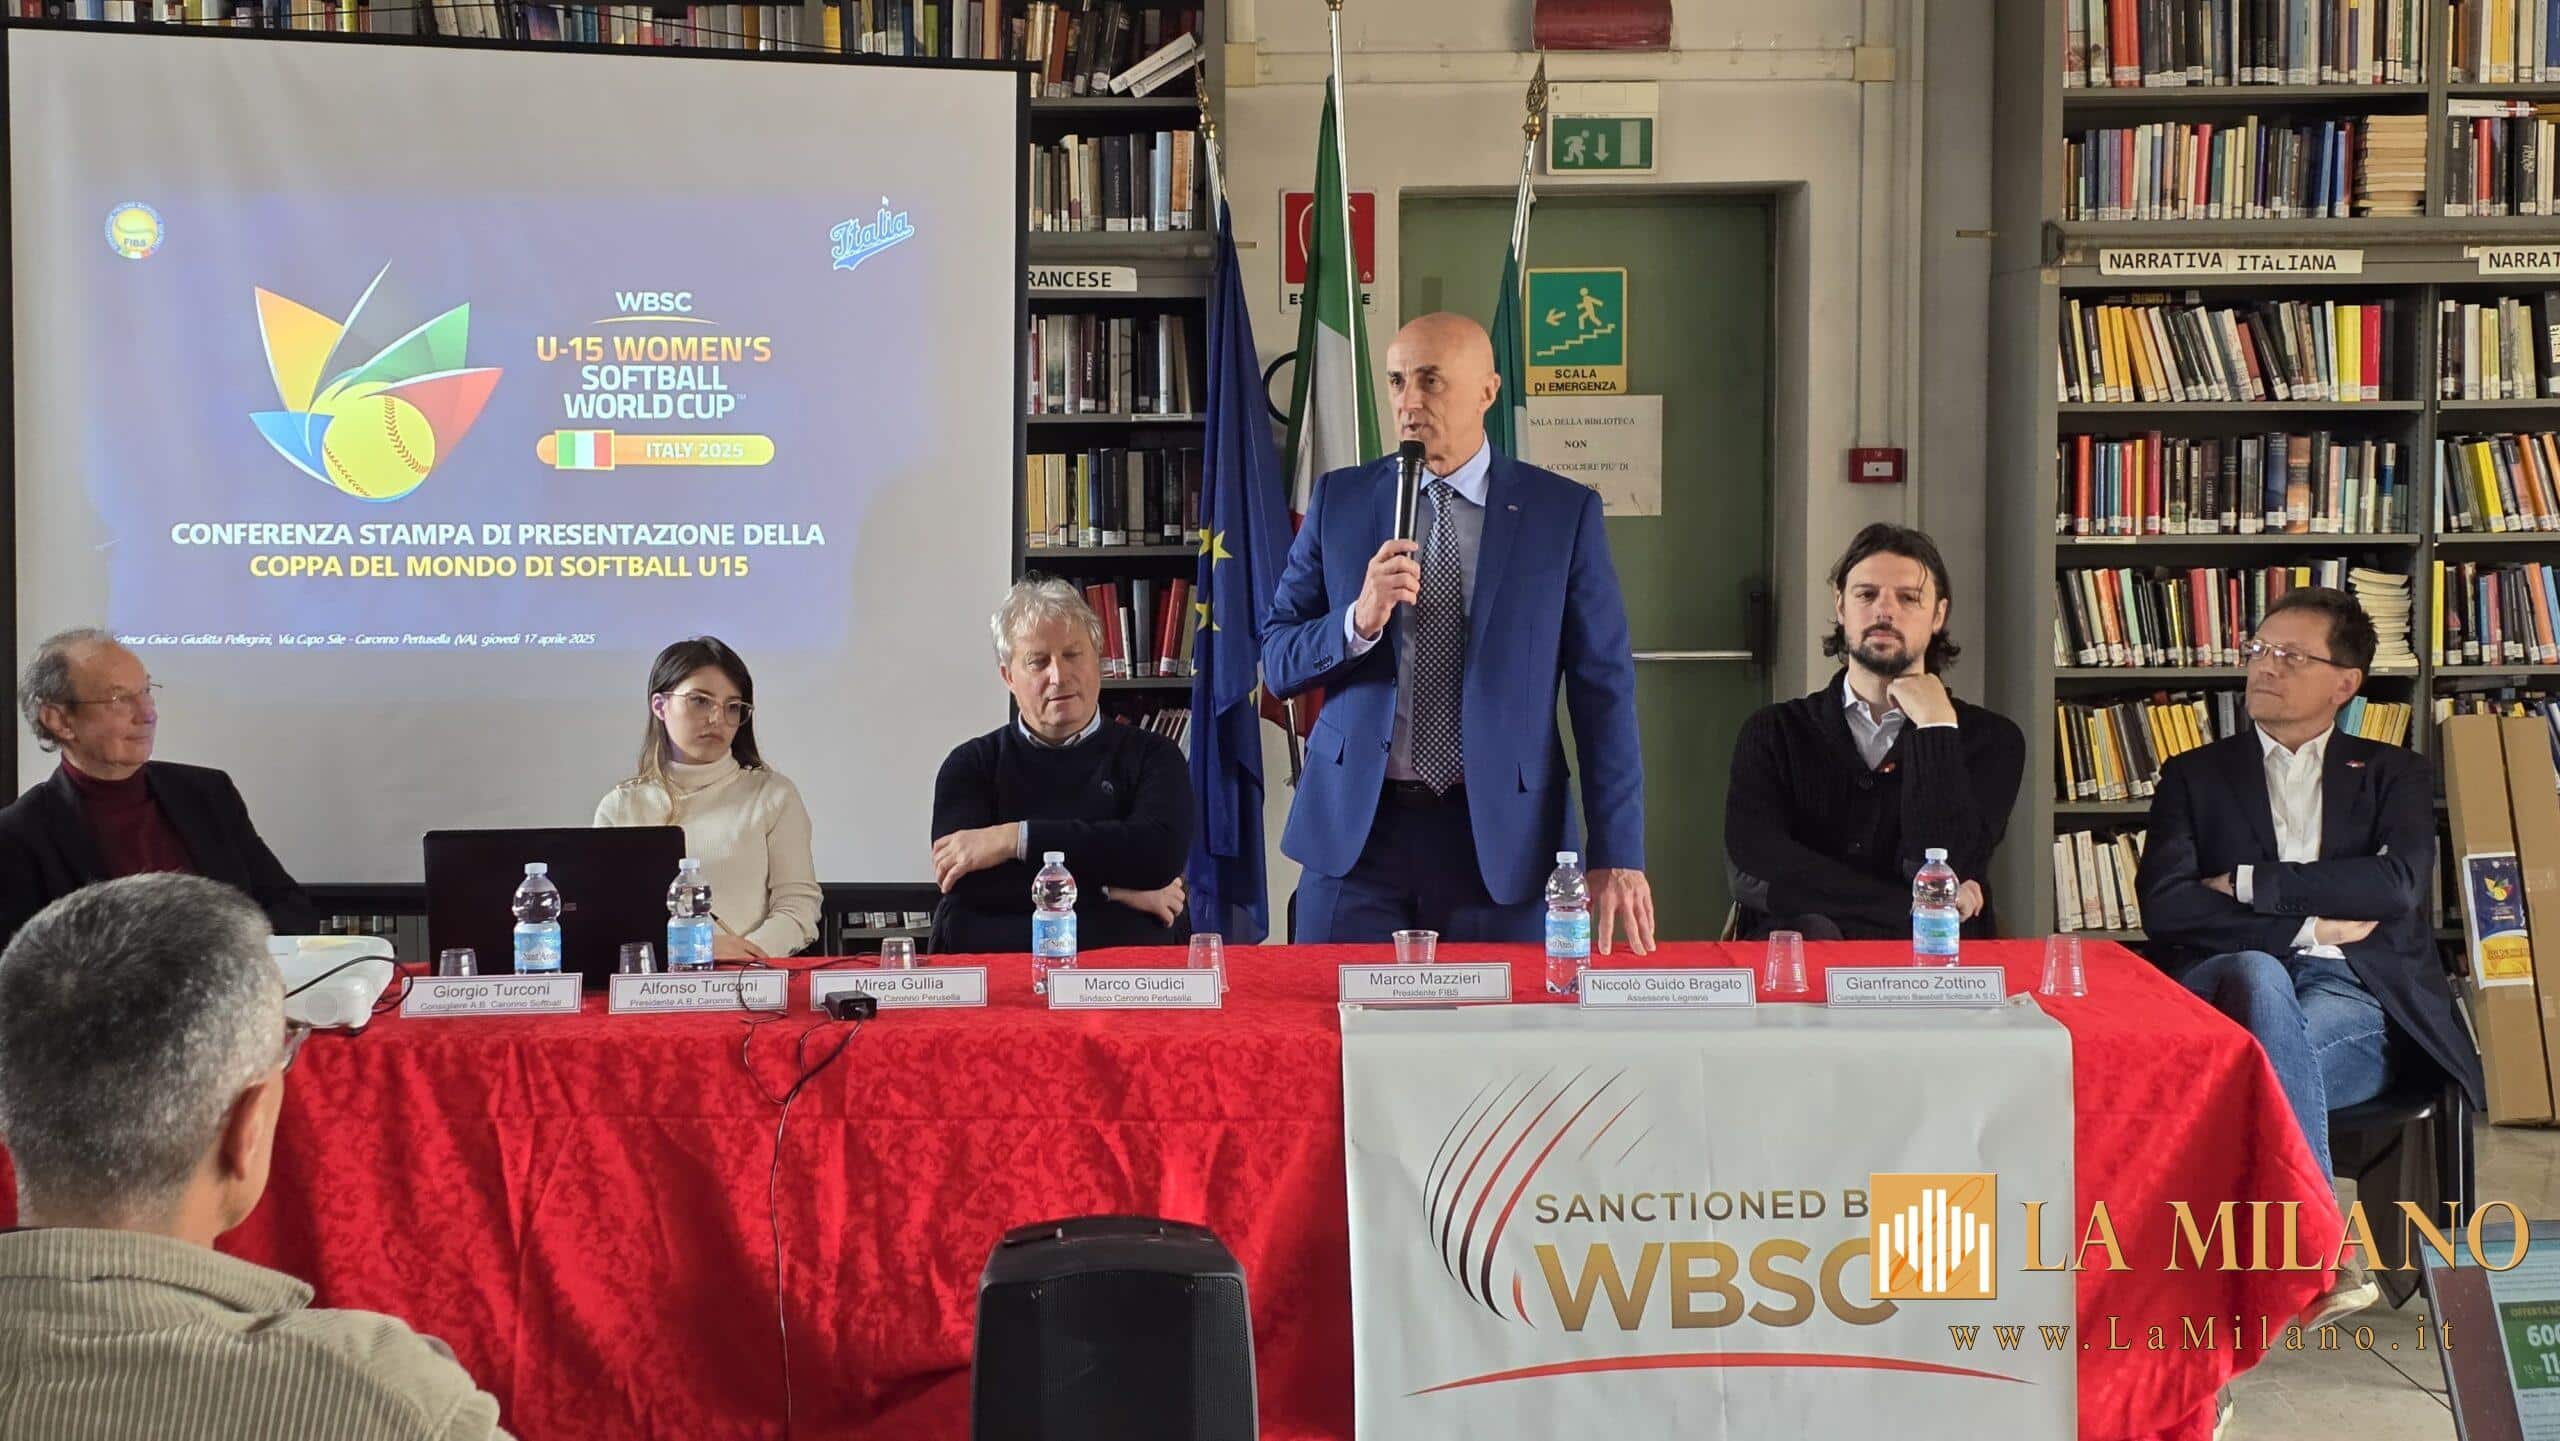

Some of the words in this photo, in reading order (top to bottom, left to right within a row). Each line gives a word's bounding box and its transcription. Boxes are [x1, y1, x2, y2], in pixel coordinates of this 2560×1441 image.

[2109, 252, 2223, 269] NARRATIVA
[2237, 254, 2337, 271] ITALIANA
[1028, 271, 1112, 288] RANCESE
[615, 291, 692, 312] WBSC
[536, 335, 604, 362] U-15
[613, 335, 772, 362] WOMEN'S
[581, 364, 728, 390] SOFTBALL
[1555, 369, 1597, 379] SCALA
[1534, 382, 1546, 392] DI
[1548, 381, 1617, 392] EMERGENZA
[563, 393, 674, 419] WORLD
[676, 393, 736, 419] CUP
[1530, 418, 1552, 426] SALA
[1554, 418, 1582, 426] DELLA
[1584, 417, 1636, 426] BIBLIOTECA
[646, 442, 694, 458] ITALY
[699, 442, 744, 458] 2025
[1564, 439, 1588, 448] NON
[170, 523, 354, 546] CONFERENZA
[358, 523, 475, 546] STAMPA
[481, 523, 512, 546] DI
[517, 523, 736, 546] PRESENTAZIONE
[743, 523, 826, 546] DELLA
[250, 555, 344, 578] COPPA
[349, 555, 399, 578] DEL
[406, 555, 518, 578] MONDO
[524, 555, 554, 578] DI
[560, 555, 693, 578] SOFTBALL
[698, 555, 750, 578] U15
[114, 634, 146, 645] oteca
[296, 634, 325, 648] Capo
[524, 633, 536, 644] 17
[569, 633, 597, 644] 2025
[855, 978, 896, 992] Mirea
[901, 977, 944, 990] Gullia
[1084, 977, 1130, 991] Marco
[1134, 977, 1185, 990] Giudici
[1370, 973, 1416, 985] Marco
[1420, 972, 1481, 985] Mazzieri
[1591, 979, 1641, 990] Niccolò
[1645, 979, 1685, 990] Guido
[1689, 979, 1742, 992] Bragato
[1846, 976, 1929, 990] Gianfranco
[1934, 977, 1986, 990] Zottino
[433, 985, 489, 1000] Giorgio
[493, 983, 551, 996] Turconi
[640, 981, 697, 995] Alfonso
[703, 980, 758, 994] Turconi
[1535, 1190, 1826, 1224] SANCTIONED
[1533, 1237, 1901, 1332] WBSC
